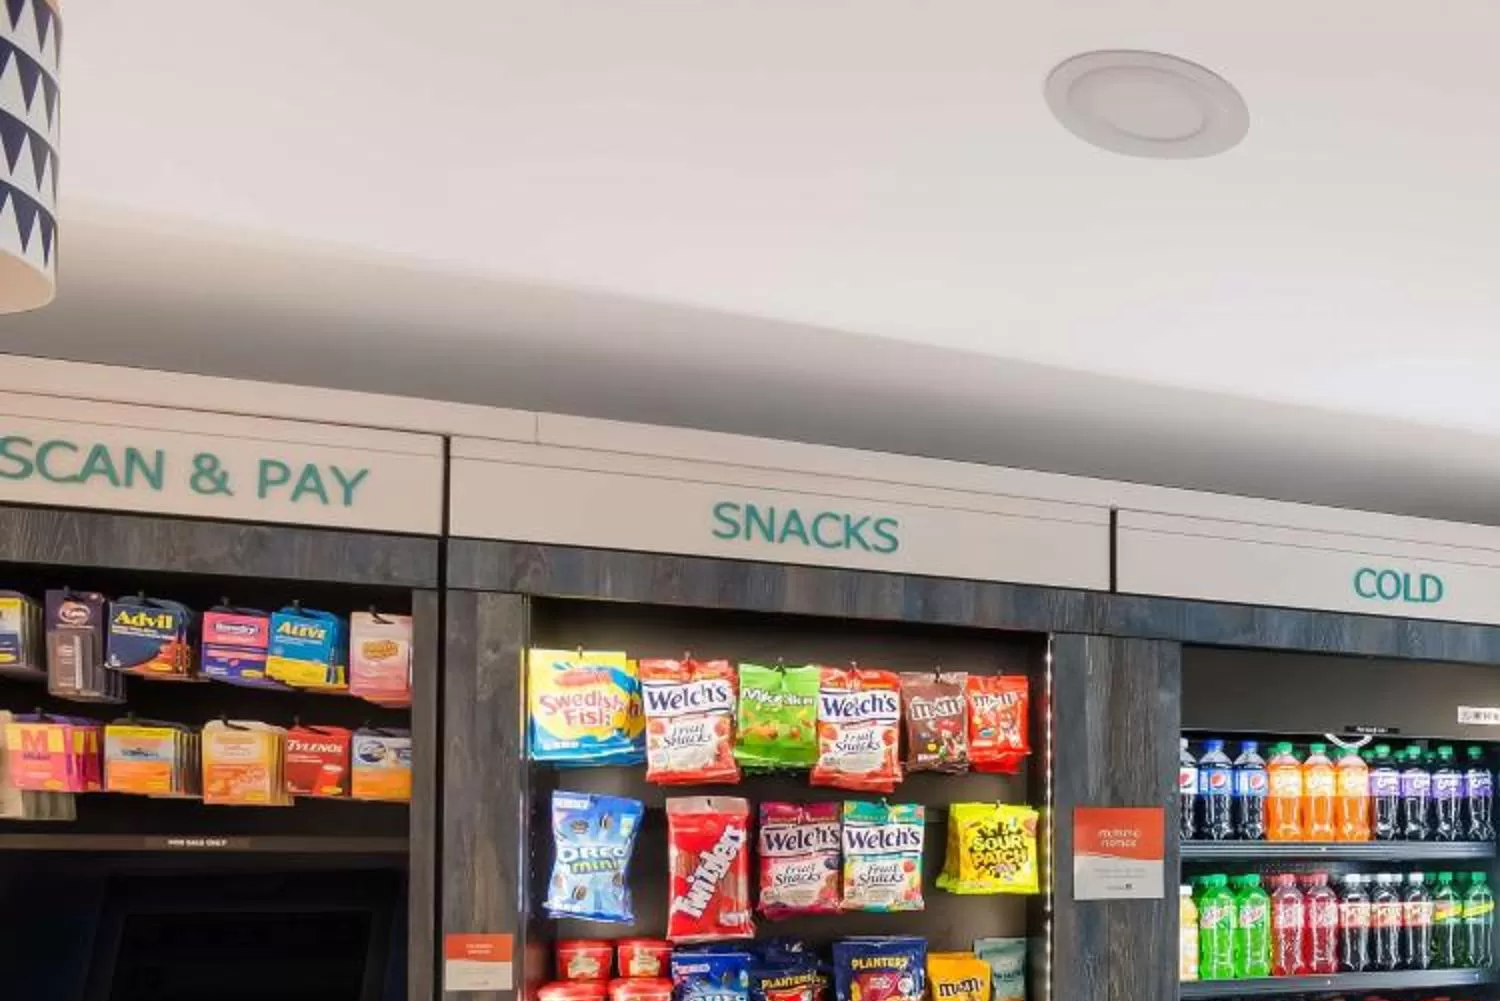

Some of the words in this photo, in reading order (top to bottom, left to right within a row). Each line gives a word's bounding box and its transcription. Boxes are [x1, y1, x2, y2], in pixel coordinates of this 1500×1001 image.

[0, 436, 163, 490] SCAN
[189, 453, 234, 497] &
[257, 458, 369, 506] PAY
[711, 501, 900, 553] SNACKS
[1354, 567, 1444, 603] COLD
[113, 610, 173, 629] Advil
[539, 690, 625, 715] Swedish
[647, 683, 728, 711] Welch's
[821, 694, 897, 718] Welch's
[564, 708, 609, 726] Fish
[764, 827, 839, 852] Welch's
[849, 826, 922, 849] Welch's
